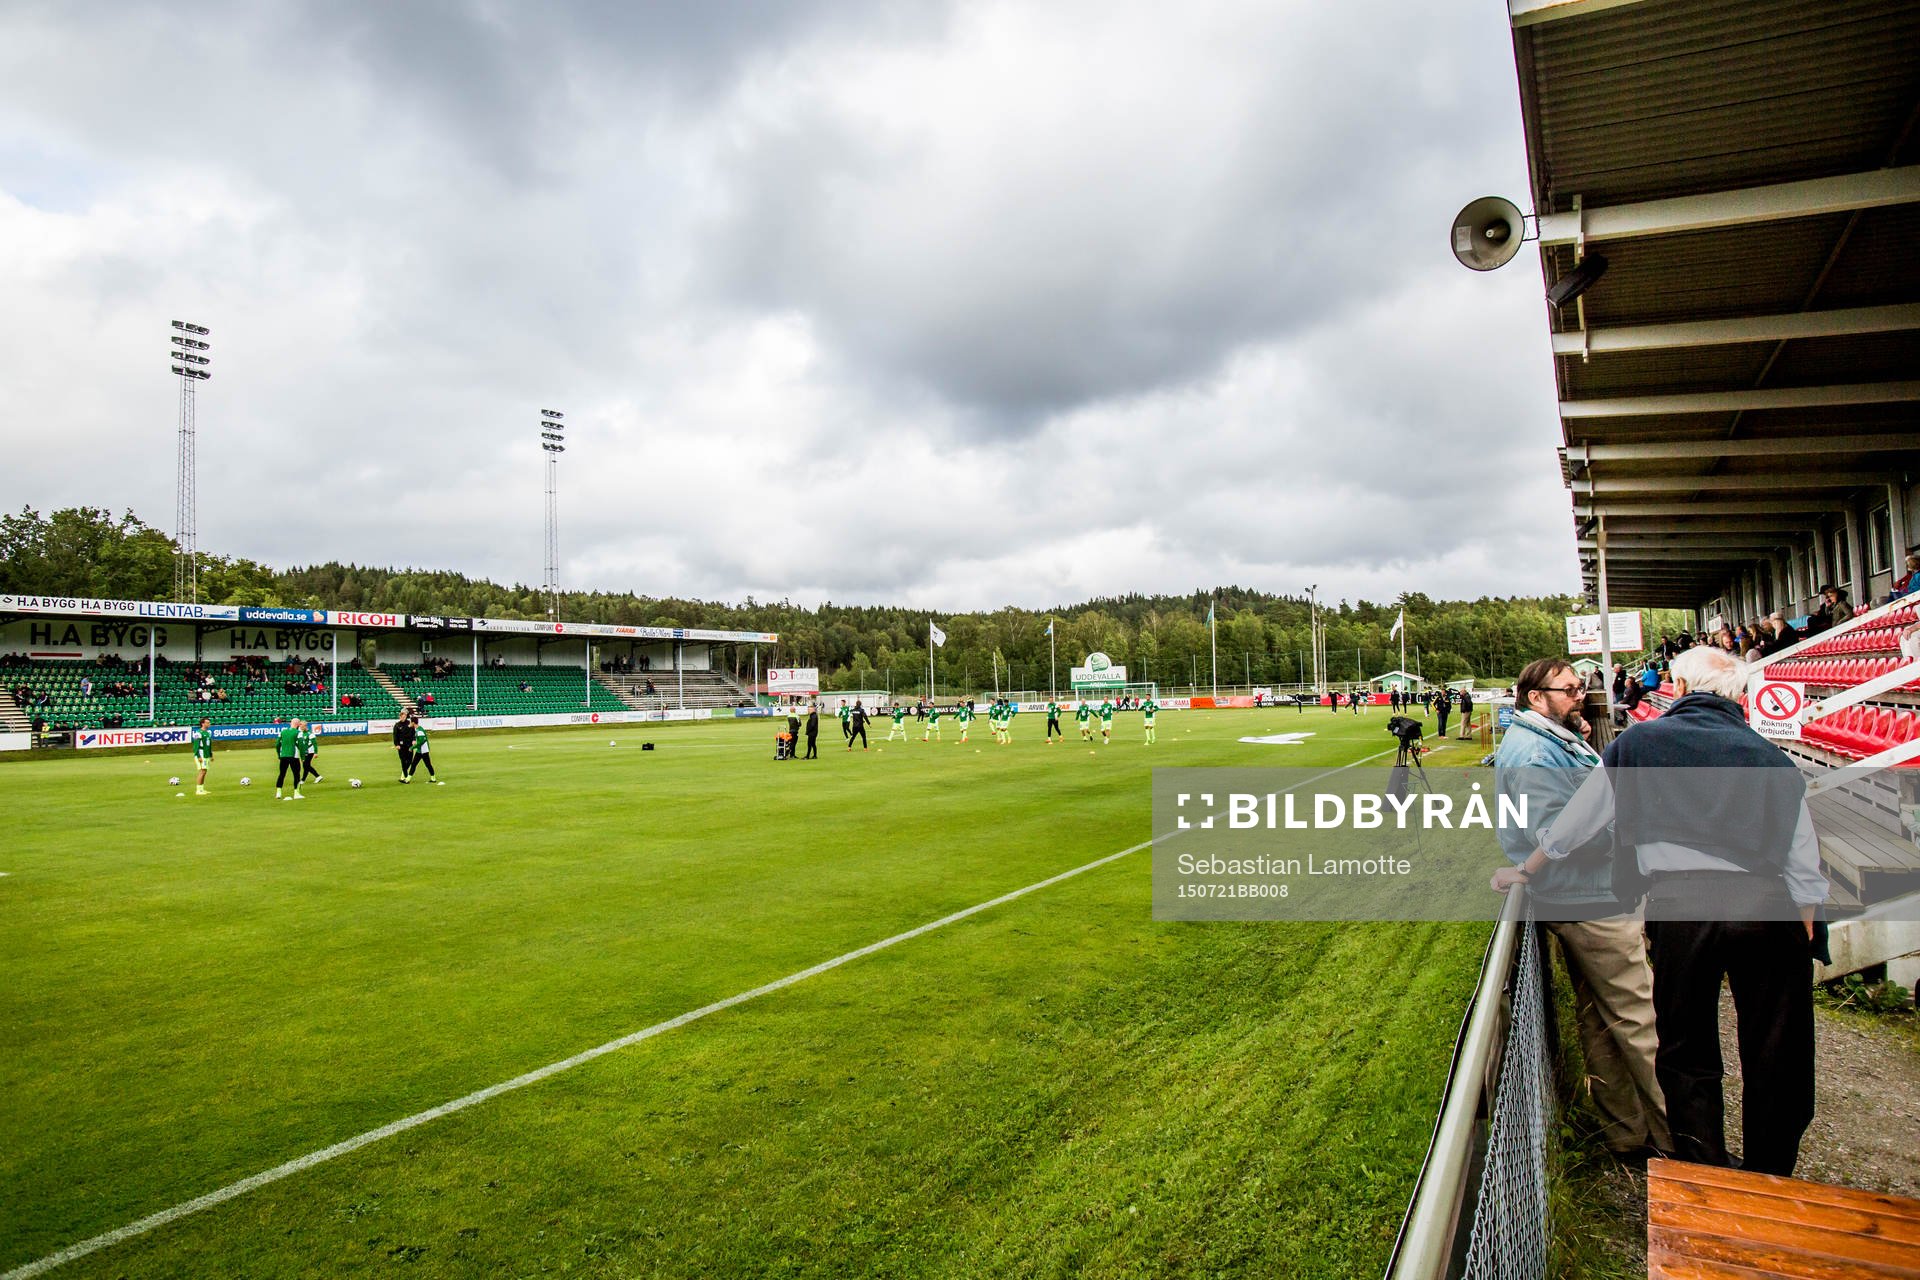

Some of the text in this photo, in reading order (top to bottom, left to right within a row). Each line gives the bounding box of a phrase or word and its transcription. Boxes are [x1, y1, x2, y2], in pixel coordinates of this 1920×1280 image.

[17, 597, 76, 609] H.A BYGG
[81, 600, 135, 611] H.A BYGG
[139, 603, 203, 618] LLENTAB
[246, 611, 307, 621] uddevalla.se
[338, 613, 396, 626] RICOH
[30, 623, 167, 647] H.A BYGG
[230, 630, 334, 651] H.A BYGG
[1075, 673, 1121, 682] UDDEVALLA
[1761, 720, 1792, 729] Rökning
[214, 727, 249, 738] SVERIGES
[1757, 727, 1794, 735] förbjuden
[98, 731, 188, 745] INTERSPORT
